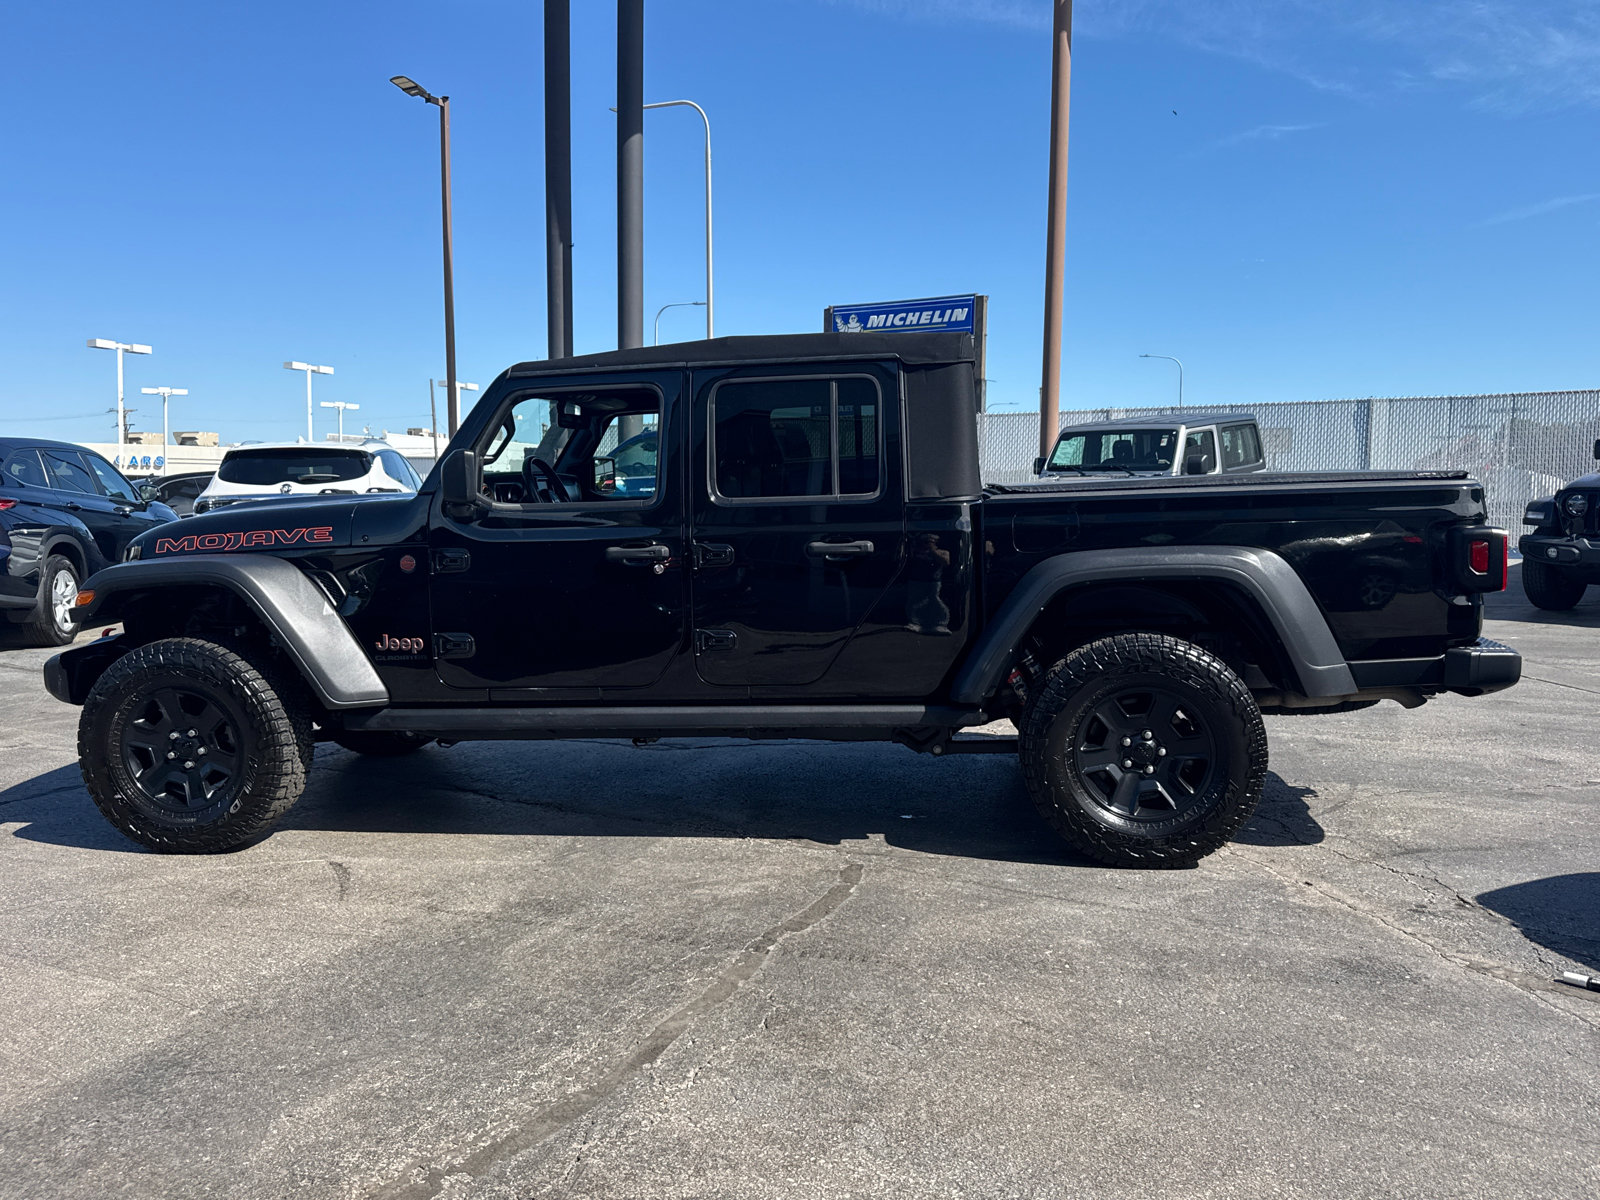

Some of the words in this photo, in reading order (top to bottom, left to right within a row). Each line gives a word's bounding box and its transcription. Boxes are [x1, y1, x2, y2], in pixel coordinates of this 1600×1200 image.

[866, 308, 969, 328] MICHELIN
[155, 526, 333, 553] MOJAVE
[375, 633, 424, 654] Jeep
